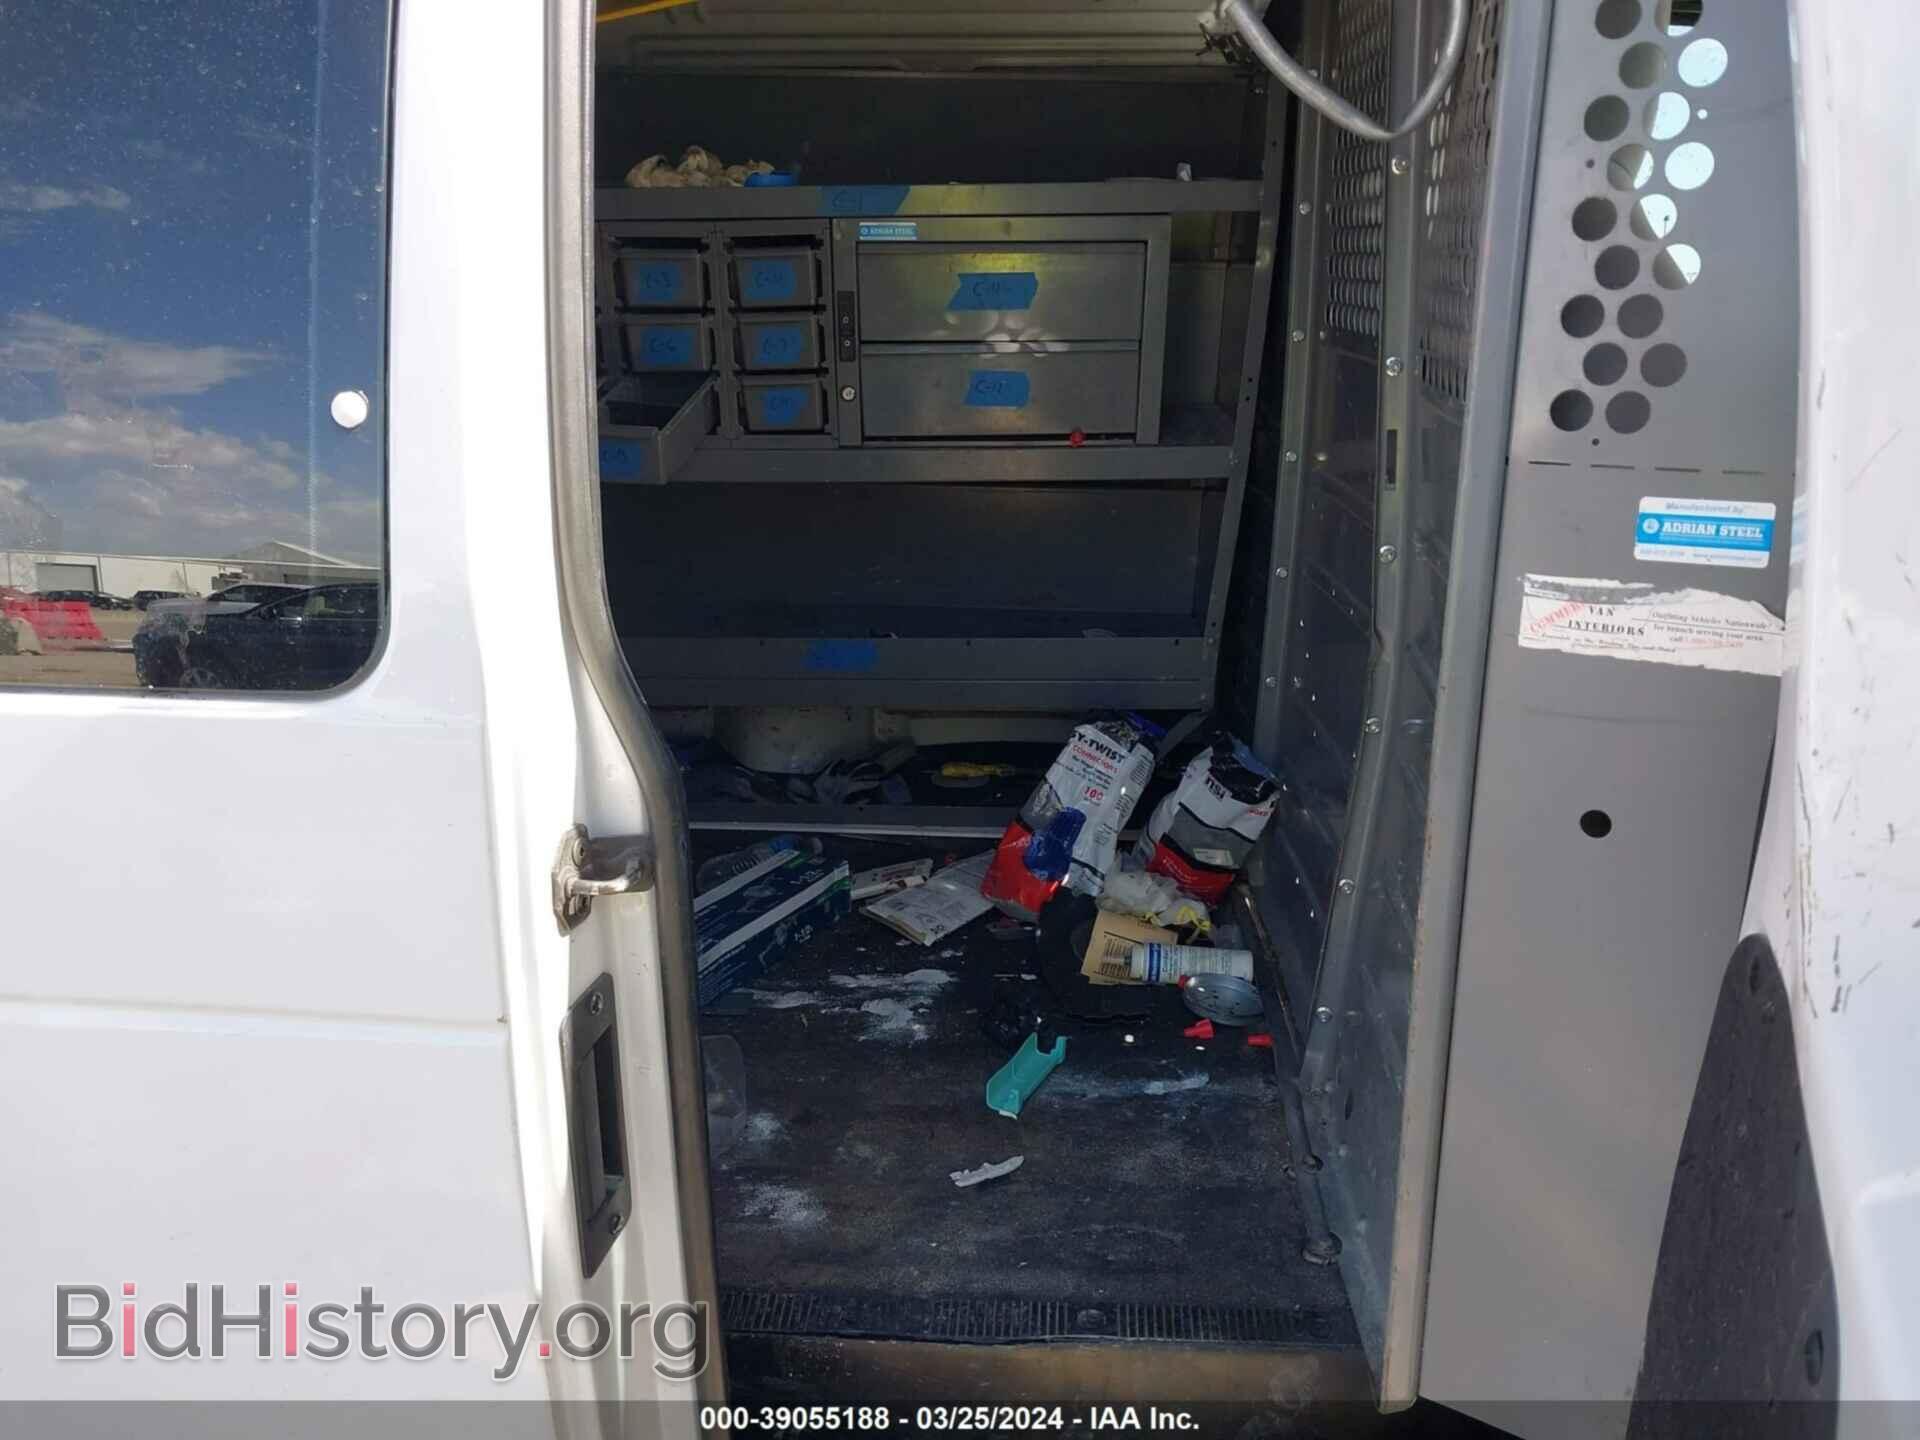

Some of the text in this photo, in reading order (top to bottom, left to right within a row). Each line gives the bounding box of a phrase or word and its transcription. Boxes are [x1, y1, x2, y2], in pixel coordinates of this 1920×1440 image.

[1661, 520, 1763, 539] ADRIAN STEEL
[1588, 604, 1616, 617] VAN
[1567, 619, 1646, 637] INTERIORS
